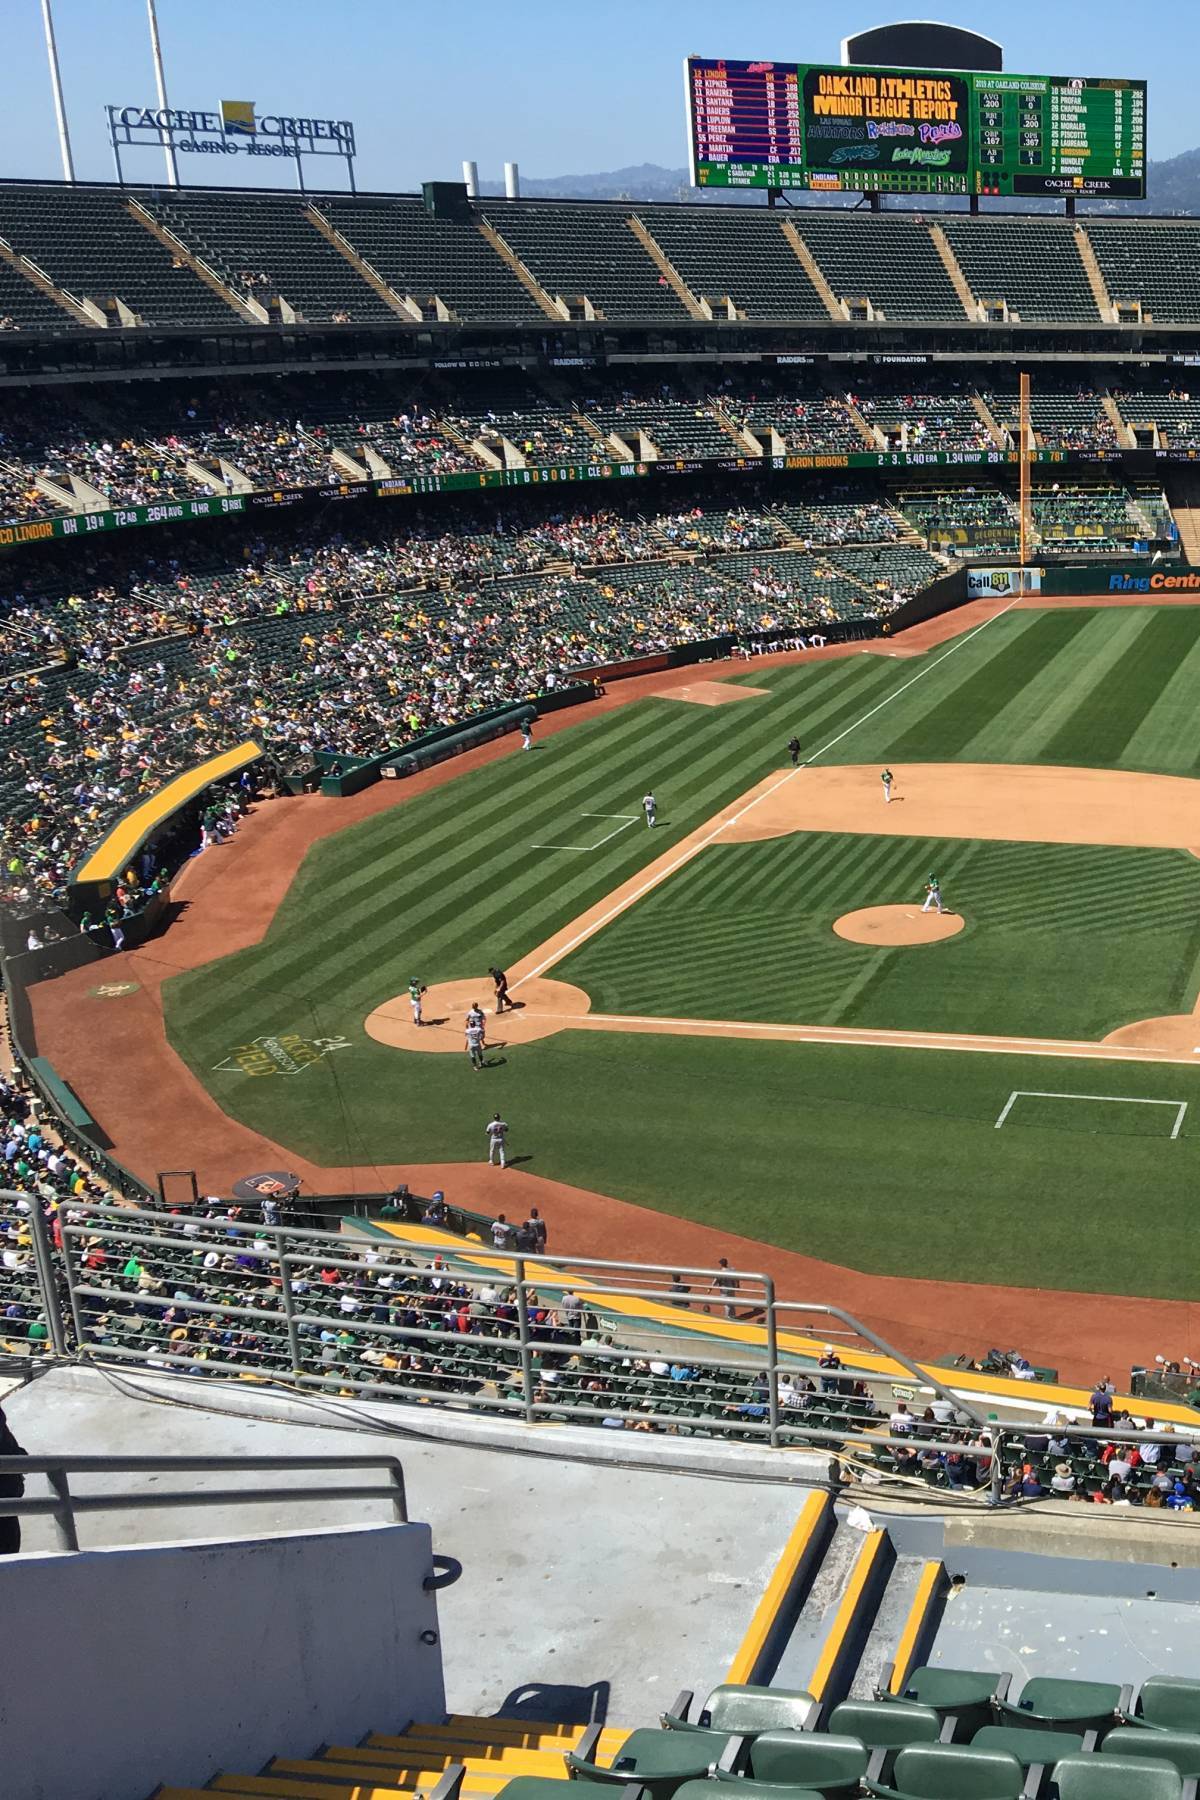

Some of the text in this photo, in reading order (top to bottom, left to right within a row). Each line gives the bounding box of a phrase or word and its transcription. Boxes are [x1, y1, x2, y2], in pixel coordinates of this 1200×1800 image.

[819, 75, 951, 100] OAKLAND ATHLETICS
[995, 81, 1019, 89] OAKLAND
[706, 98, 734, 106] SANTANA
[814, 95, 958, 120] MINOR LEAGUE REPORT
[119, 107, 352, 139] CACHE CREEK
[707, 125, 736, 133] FREEMAN
[708, 134, 727, 142] PEREZ
[178, 139, 239, 155] CASINO
[812, 172, 838, 181] INDIANS
[1044, 180, 1111, 189] CACHE CREEK
[620, 464, 635, 475] OAK
[772, 455, 848, 469] 35 AARON BROOKS
[15, 522, 54, 543] LINDOR
[62, 519, 78, 534] DH
[968, 572, 1009, 589] Call 811
[277, 1034, 323, 1064] RICKEY
[230, 1043, 279, 1076] FIELD
